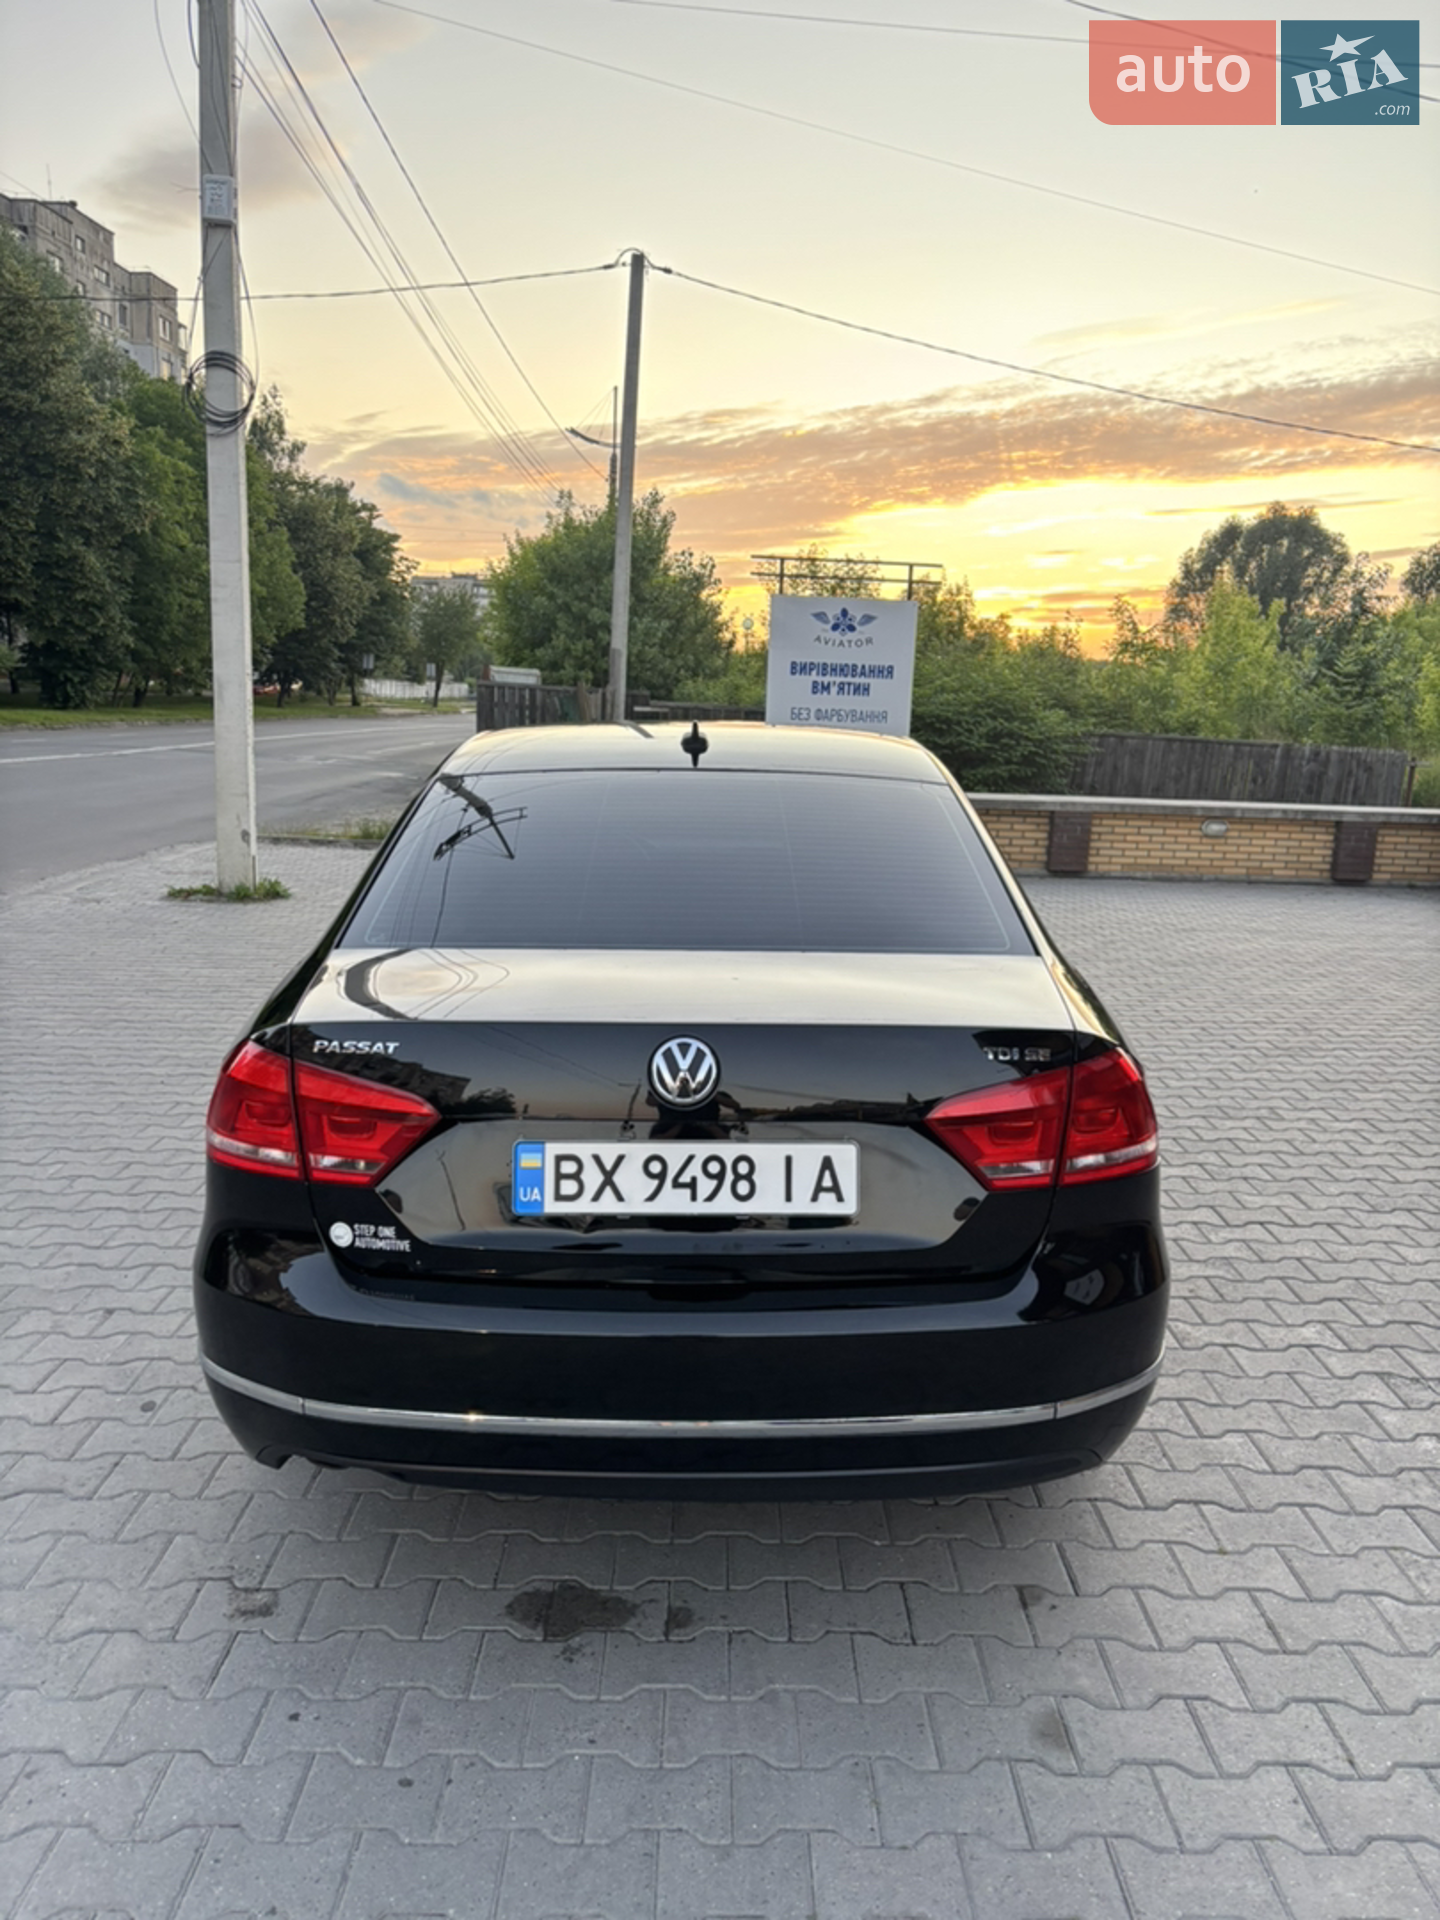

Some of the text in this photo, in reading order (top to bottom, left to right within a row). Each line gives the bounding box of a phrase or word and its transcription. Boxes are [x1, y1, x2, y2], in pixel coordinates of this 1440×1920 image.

[813, 634, 874, 648] AVIATOR
[790, 660, 894, 680] ВИРІВНЮВАННЯ
[790, 707, 888, 724] БЕЗ ФАРБУВАННЯ
[313, 1040, 400, 1054] PASSAT
[983, 1047, 1020, 1061] TDI
[553, 1154, 845, 1203] BX 9498 IA
[519, 1187, 541, 1202] UA
[353, 1223, 396, 1238] STEP ONE
[354, 1237, 411, 1252] AUTOMOTIVE
